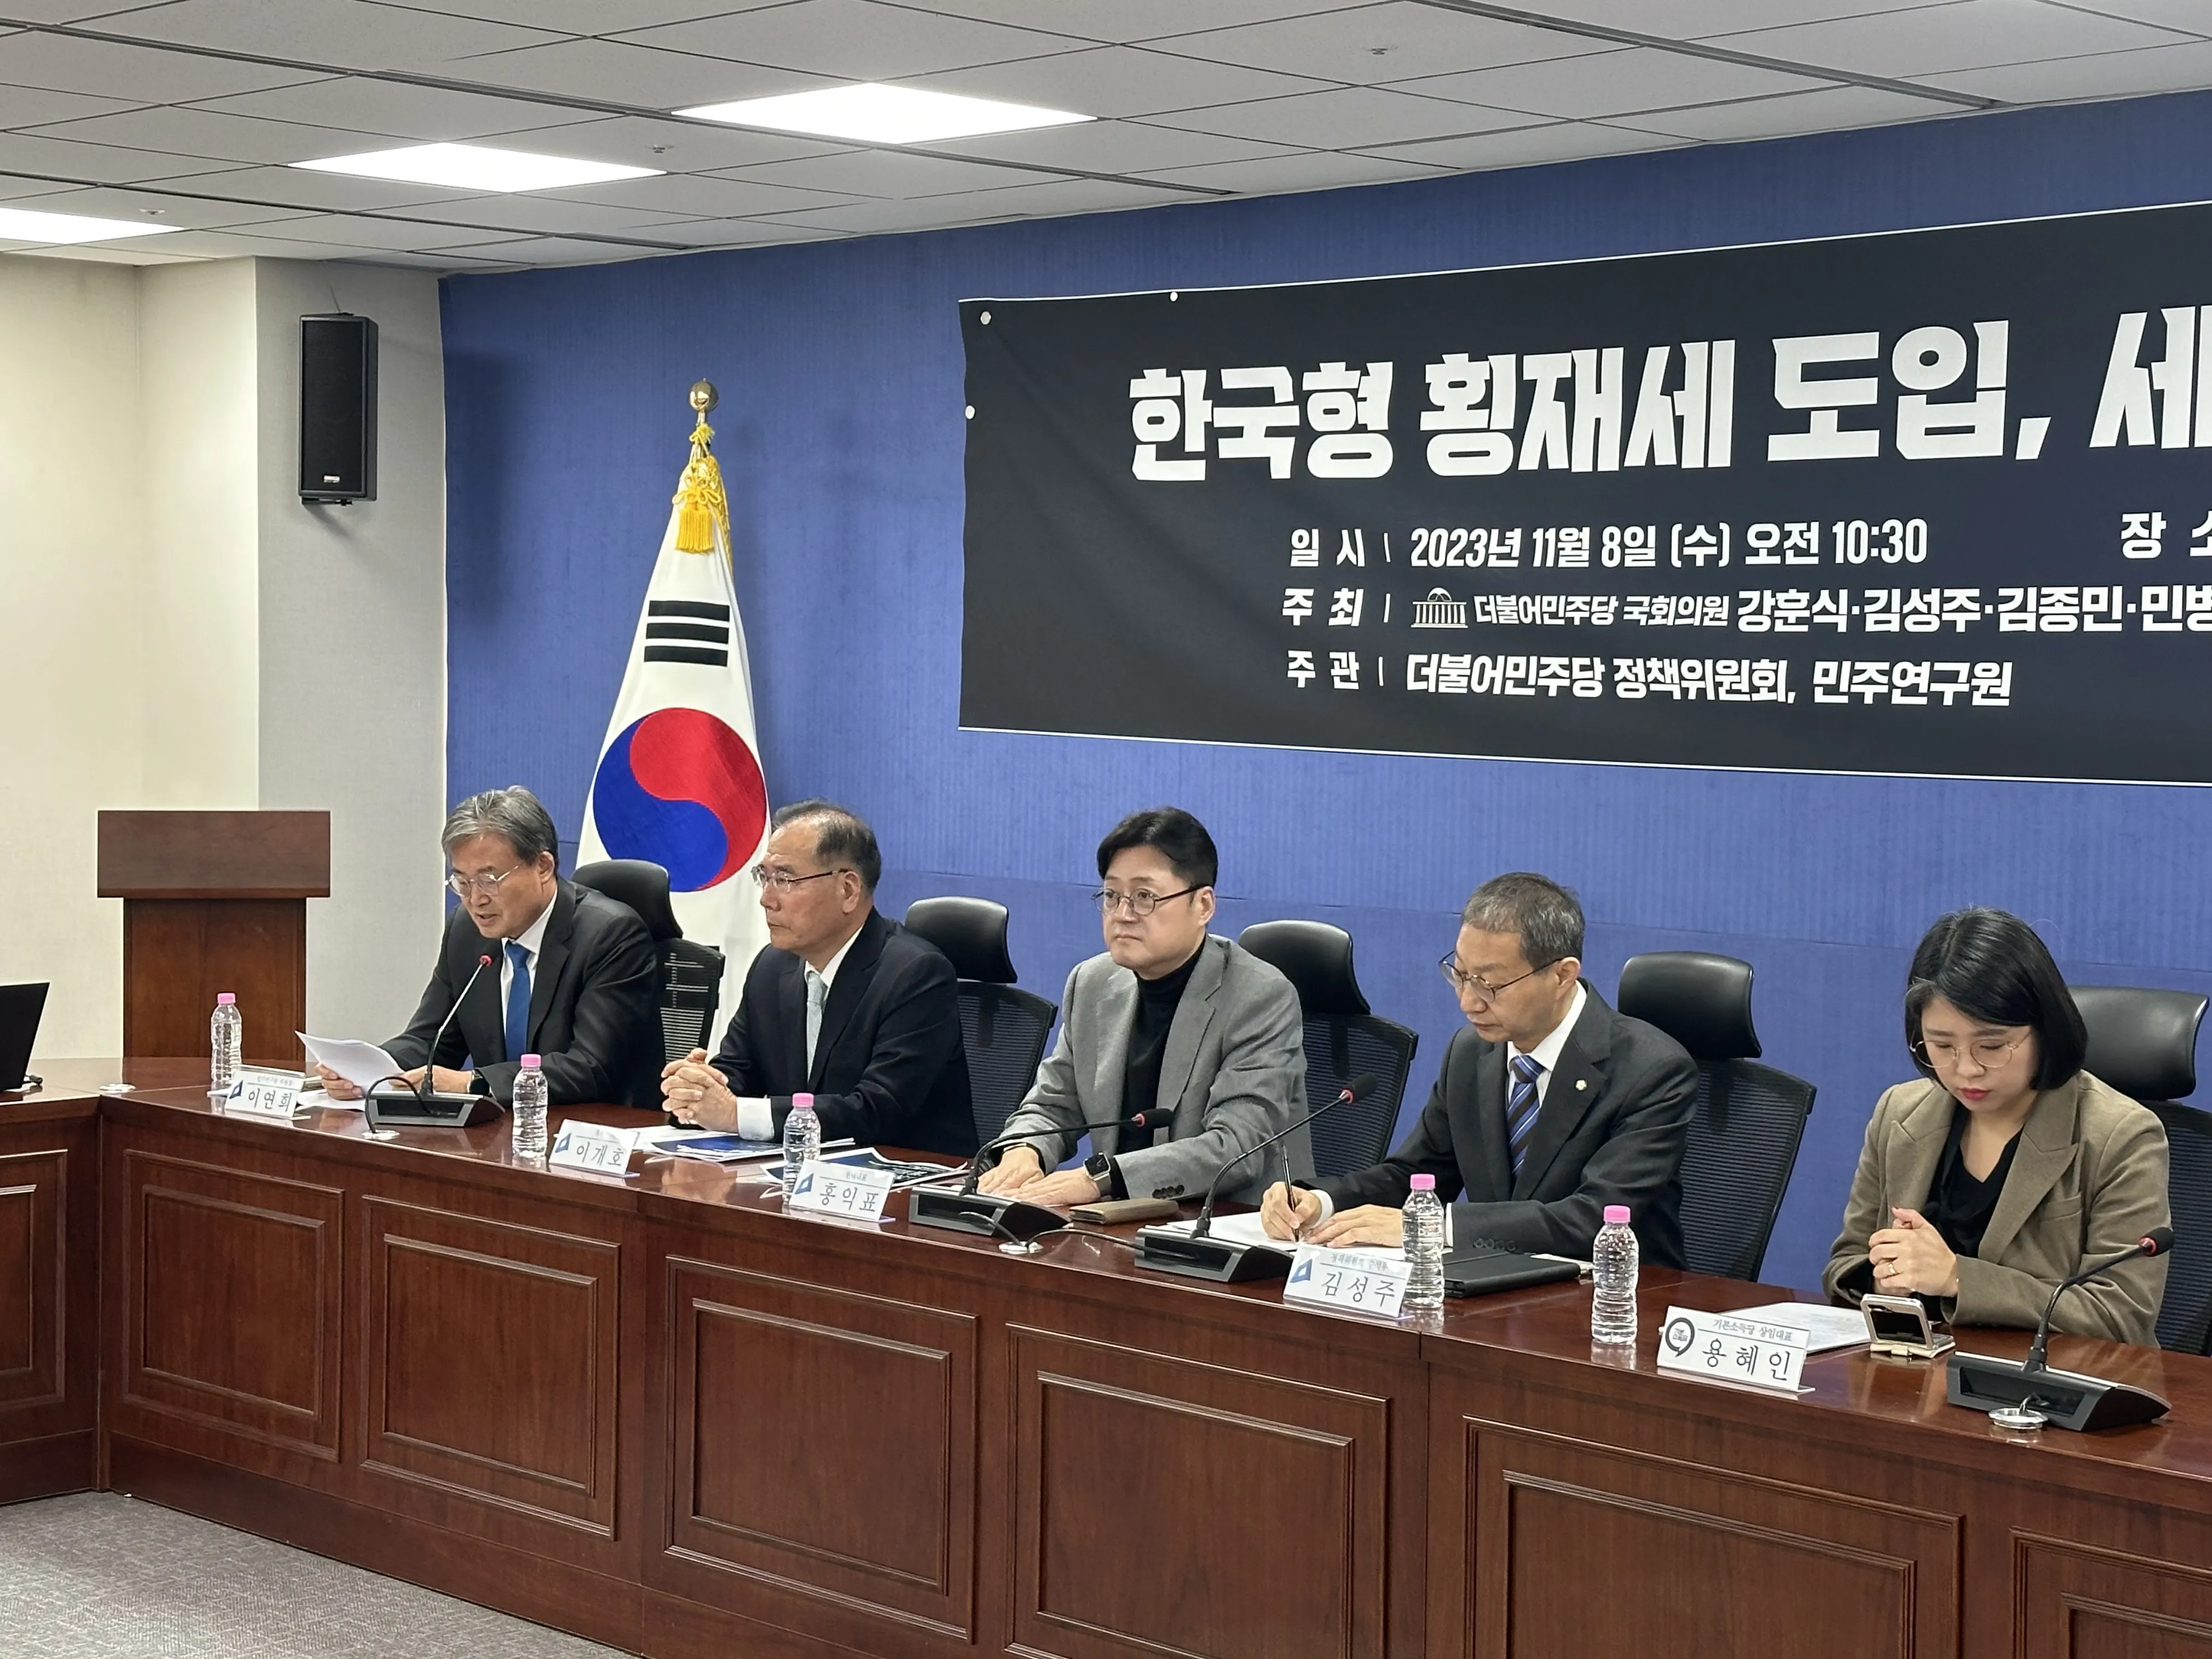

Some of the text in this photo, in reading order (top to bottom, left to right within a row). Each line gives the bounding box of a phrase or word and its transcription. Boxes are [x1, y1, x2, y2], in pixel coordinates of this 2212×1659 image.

[1129, 361, 1394, 481] 한국형
[1419, 339, 1736, 477] 횡재세
[1767, 319, 2052, 461] 도입,
[1410, 528, 1522, 568] 2023년
[1532, 527, 1590, 568] 11월
[1601, 525, 1656, 568] 8일
[1745, 521, 1819, 565] 오전
[1832, 518, 1927, 564] 10:30
[1474, 595, 1619, 625] 더불어민주당
[1623, 595, 1729, 626] 국회의원
[1407, 653, 1606, 698] 더불어민주당
[1613, 657, 1796, 704] 정책위원회,
[1813, 661, 2013, 706] 민주연구원
